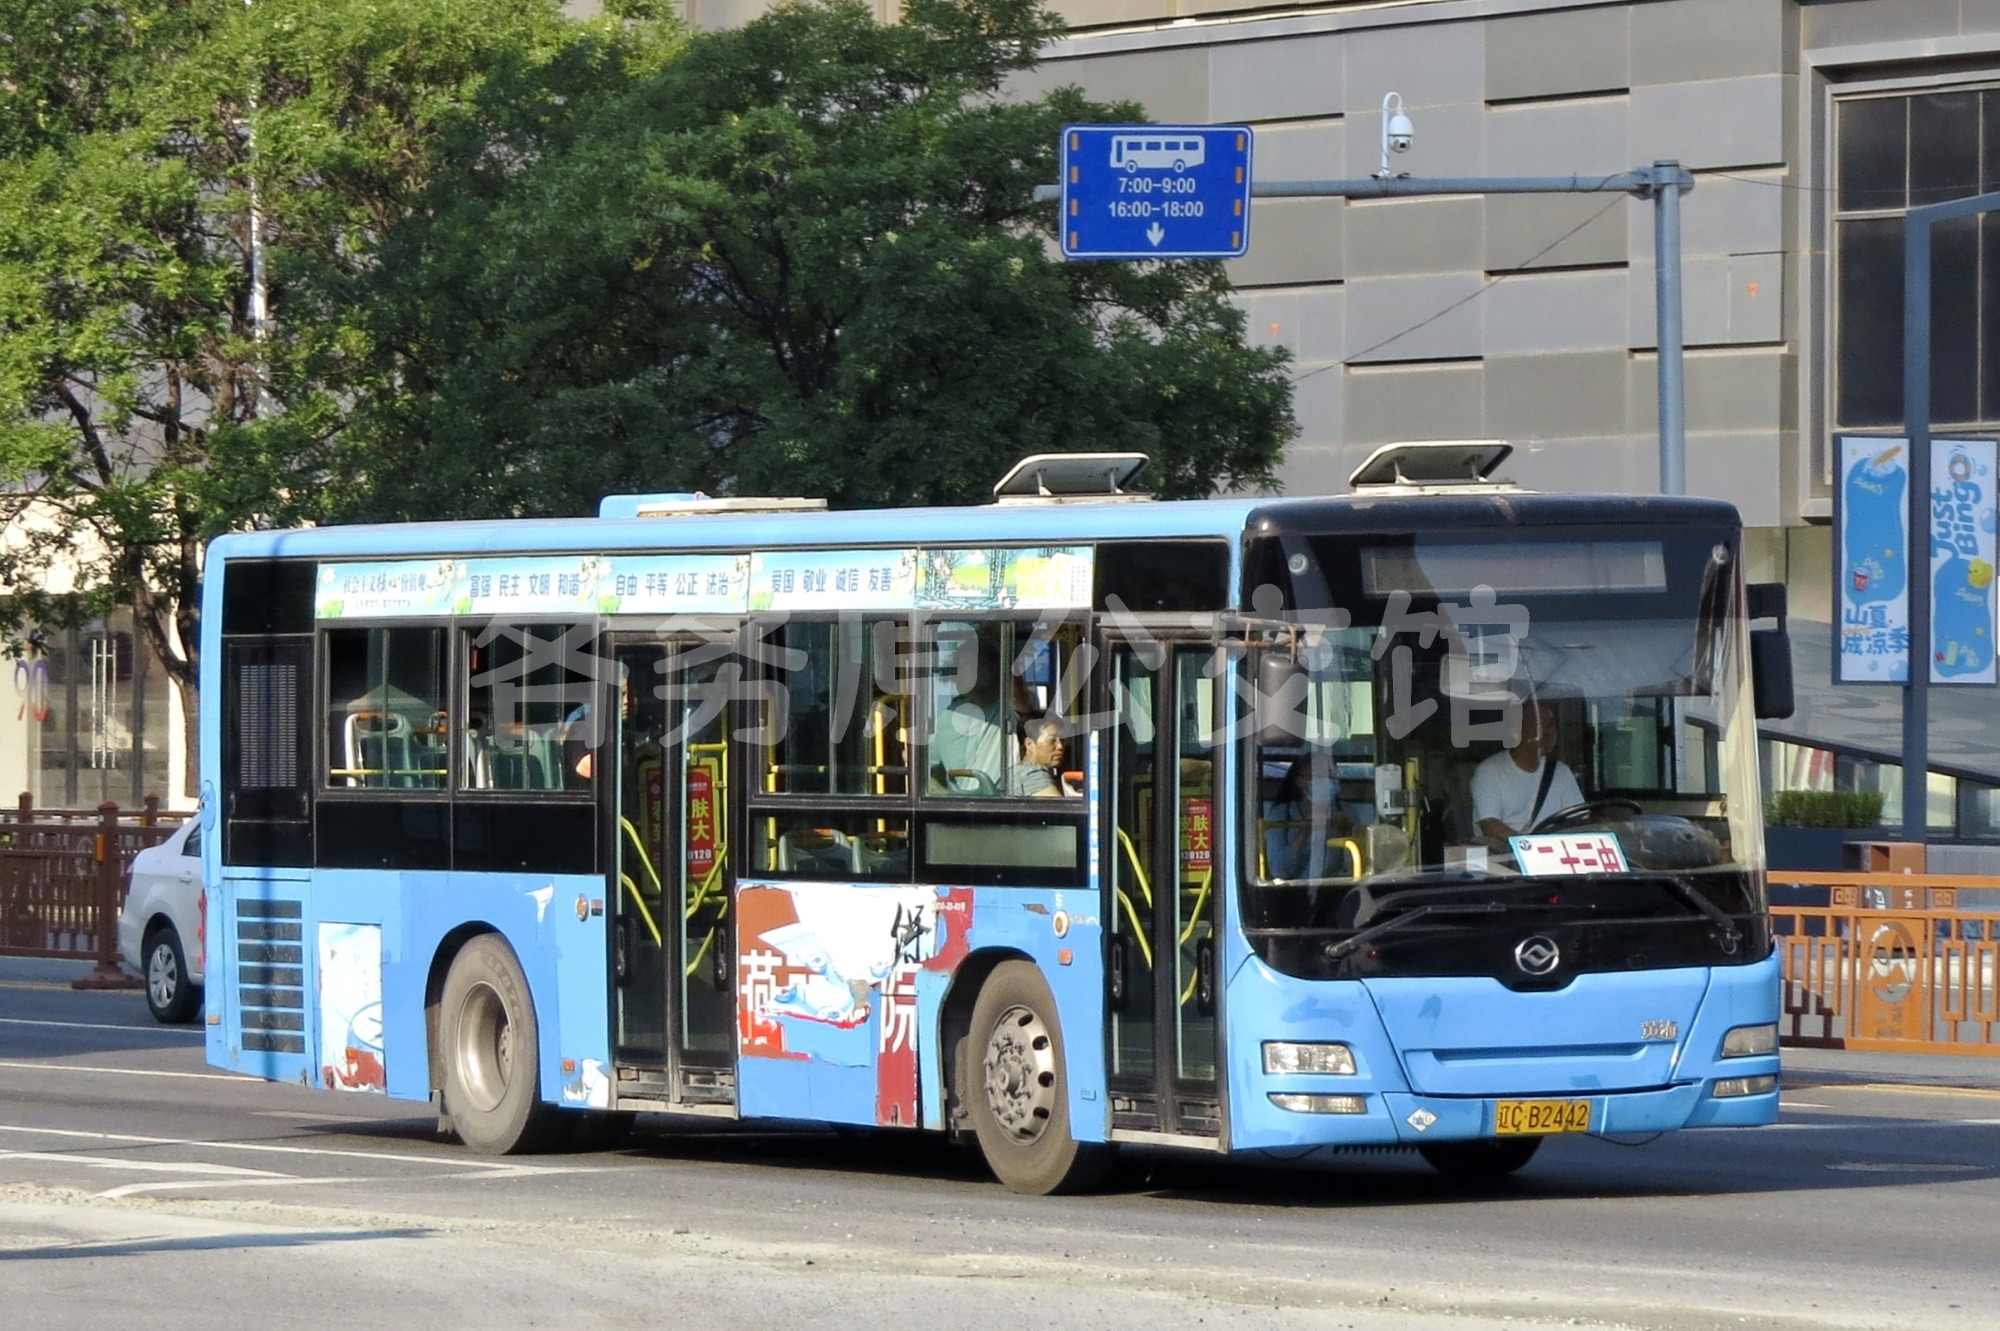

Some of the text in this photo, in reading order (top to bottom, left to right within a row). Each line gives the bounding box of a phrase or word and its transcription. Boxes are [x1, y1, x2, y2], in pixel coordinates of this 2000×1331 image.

[1118, 177, 1196, 194] 7:00-9:00
[1108, 201, 1205, 217] 16:00-18:00
[470, 572, 579, 598] 富强 民主 文明 和谐
[615, 571, 729, 597] 自由 平等 公正 法治
[771, 567, 892, 593] 爱国 敬业 诚信 友善
